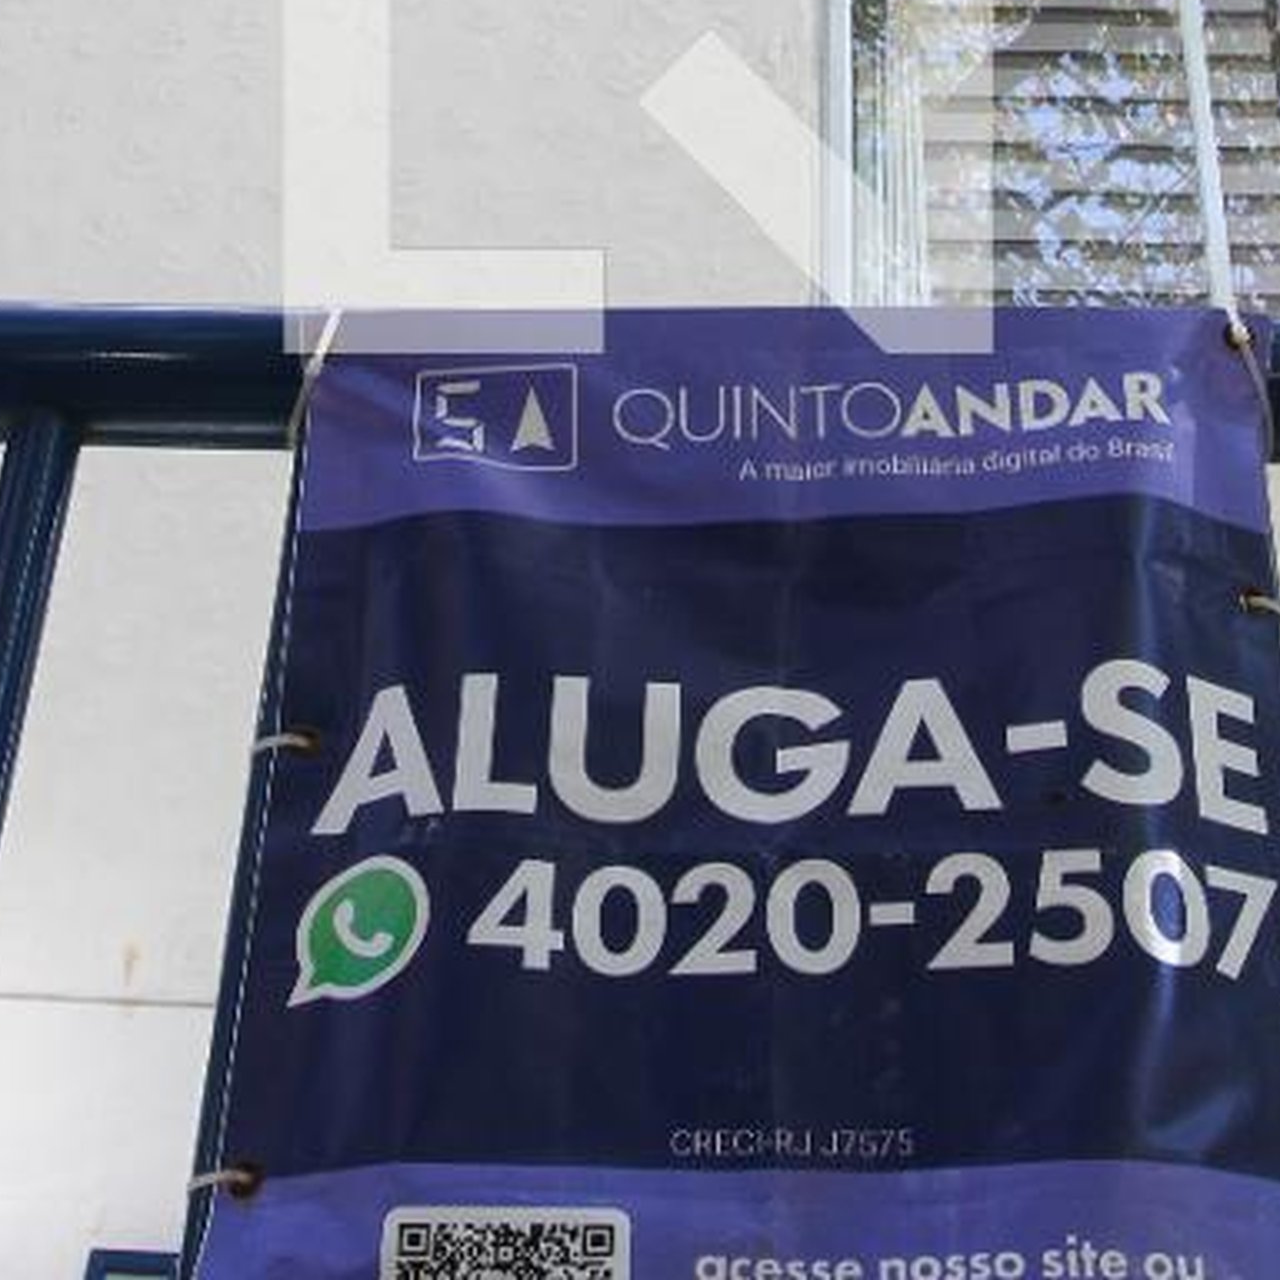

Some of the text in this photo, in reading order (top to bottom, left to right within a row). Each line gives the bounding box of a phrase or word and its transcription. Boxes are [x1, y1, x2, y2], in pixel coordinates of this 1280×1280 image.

[612, 372, 1172, 450] QUINTOANDAR
[739, 459, 758, 481] A
[766, 462, 834, 481] maior
[982, 445, 1061, 471] digital
[1066, 442, 1100, 462] do
[310, 658, 1270, 837] ALUGA-SE
[466, 847, 1280, 982] 4020-2507
[695, 1234, 1205, 1280] acesse nosso site ou
